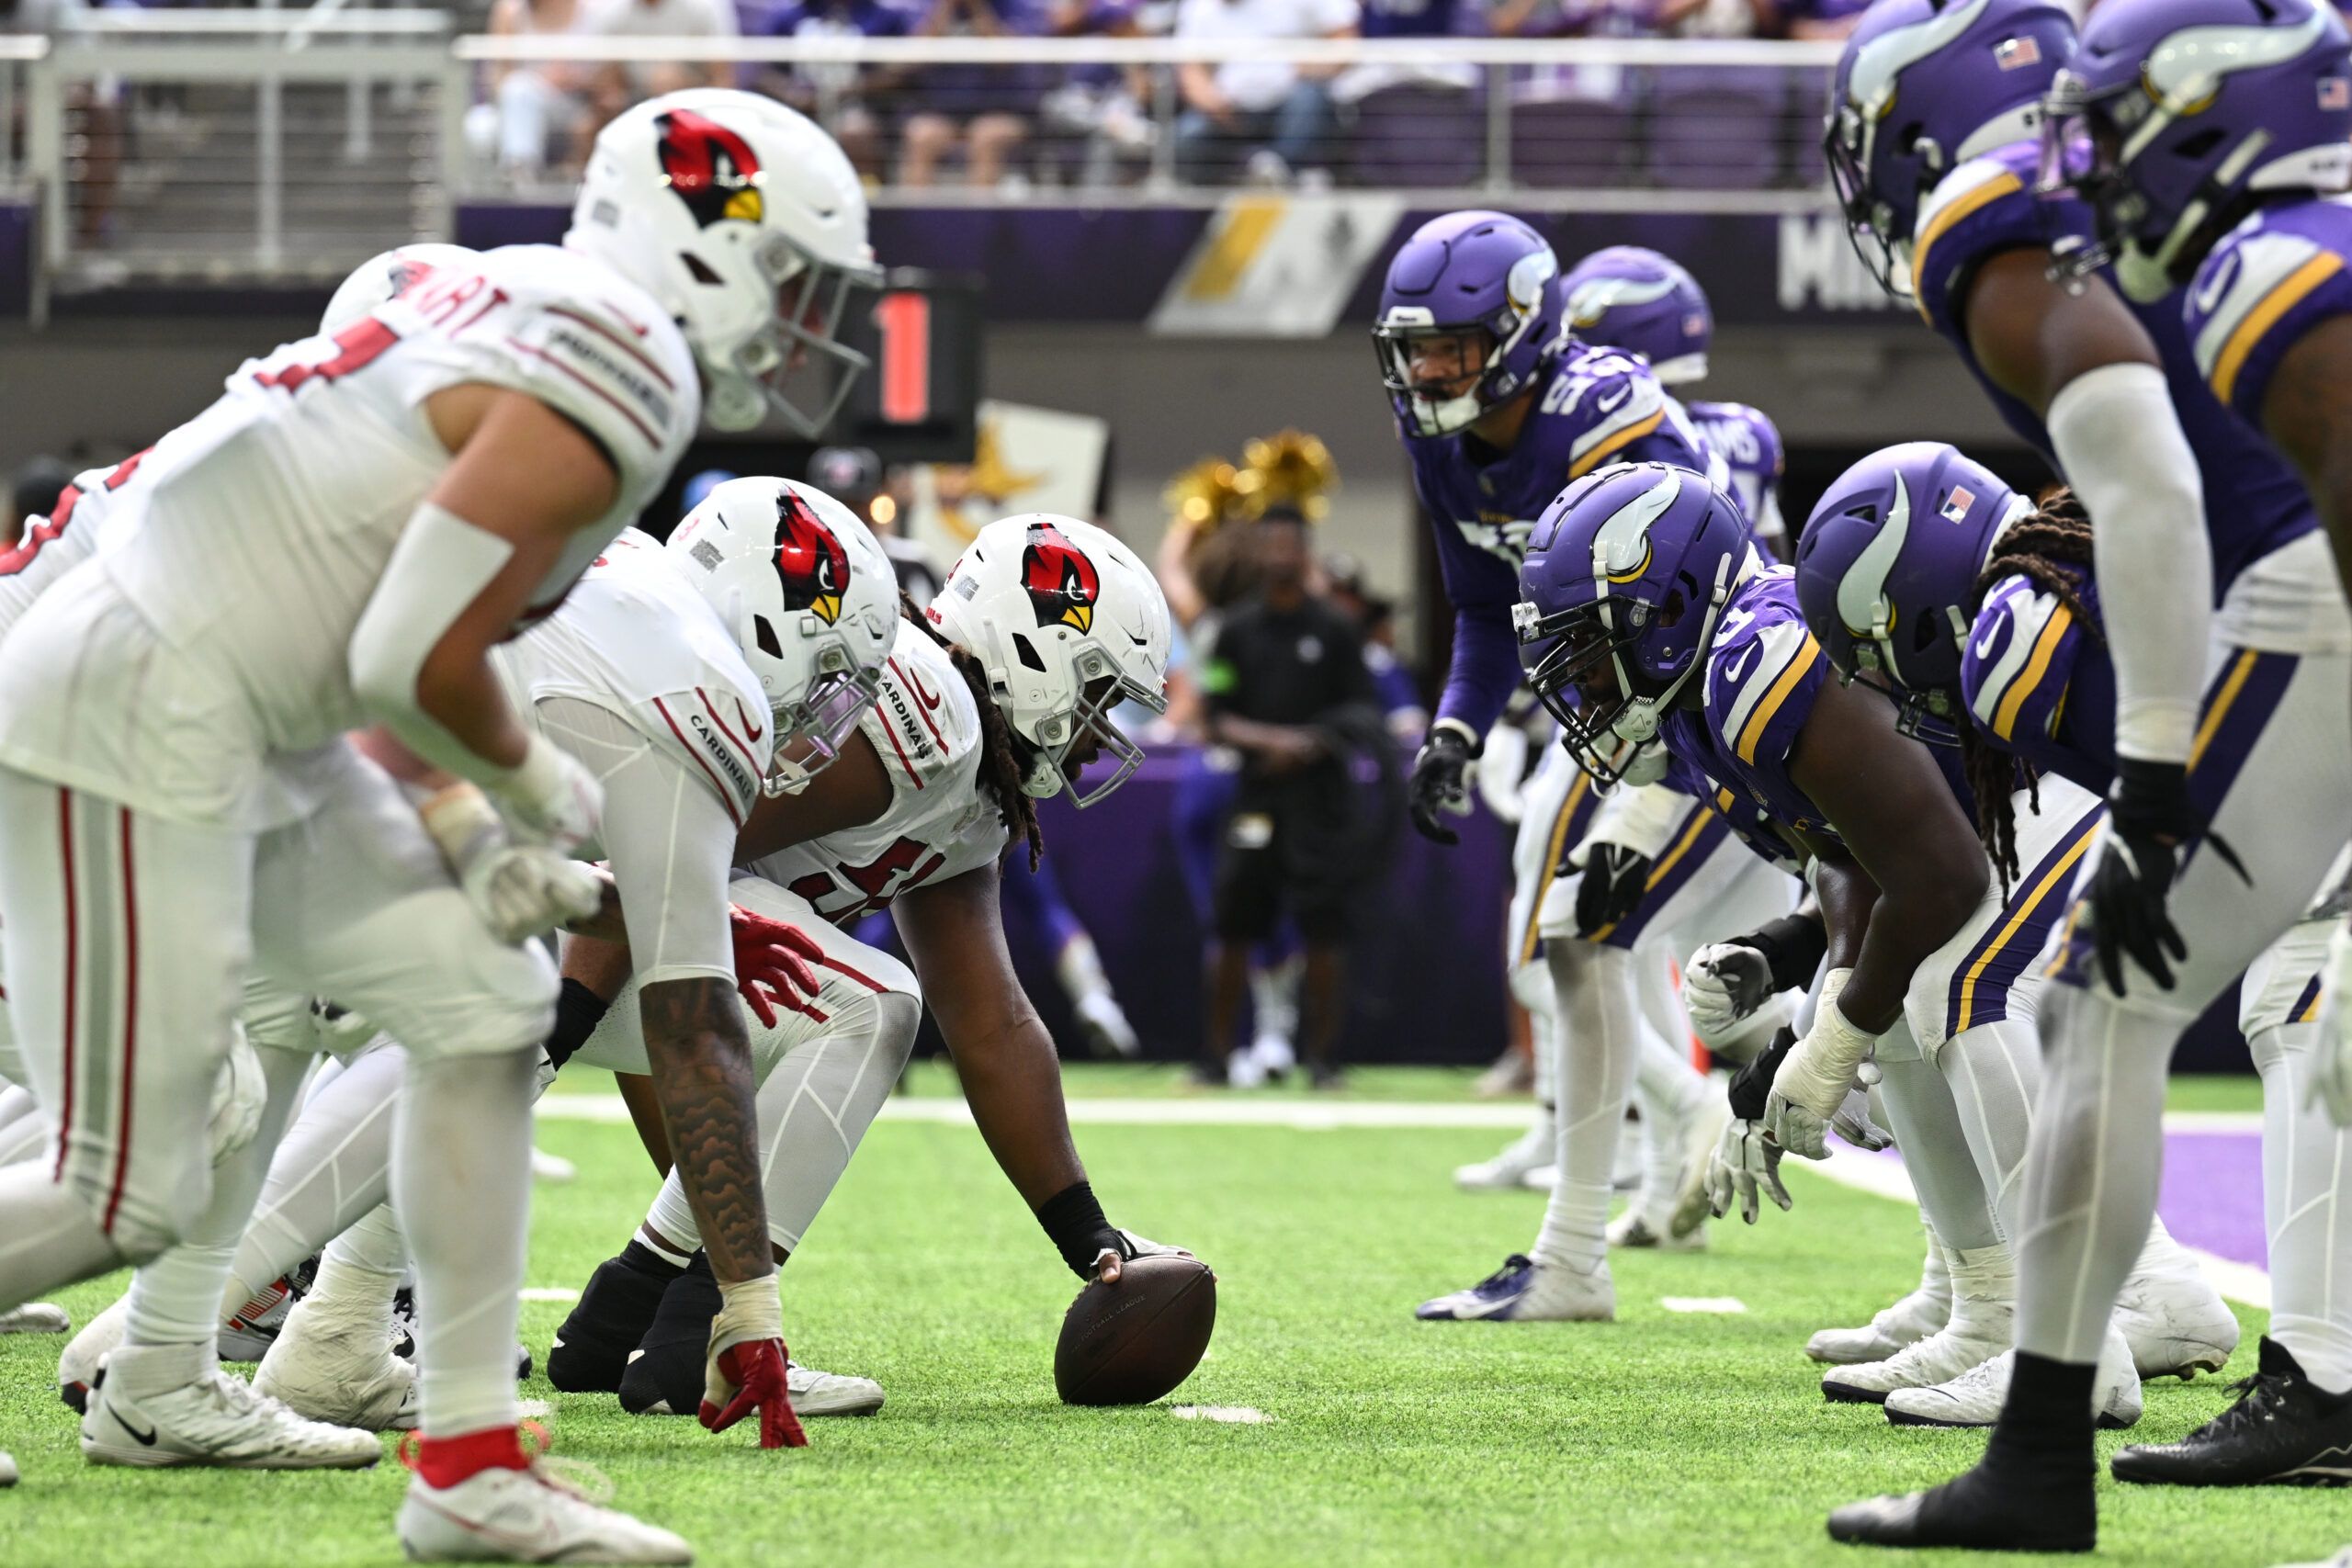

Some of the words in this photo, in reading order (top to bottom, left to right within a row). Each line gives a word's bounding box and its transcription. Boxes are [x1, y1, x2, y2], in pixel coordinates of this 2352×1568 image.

[871, 291, 932, 425] 1
[690, 714, 752, 800] CARDINALS
[881, 674, 931, 760] ARDINALS
